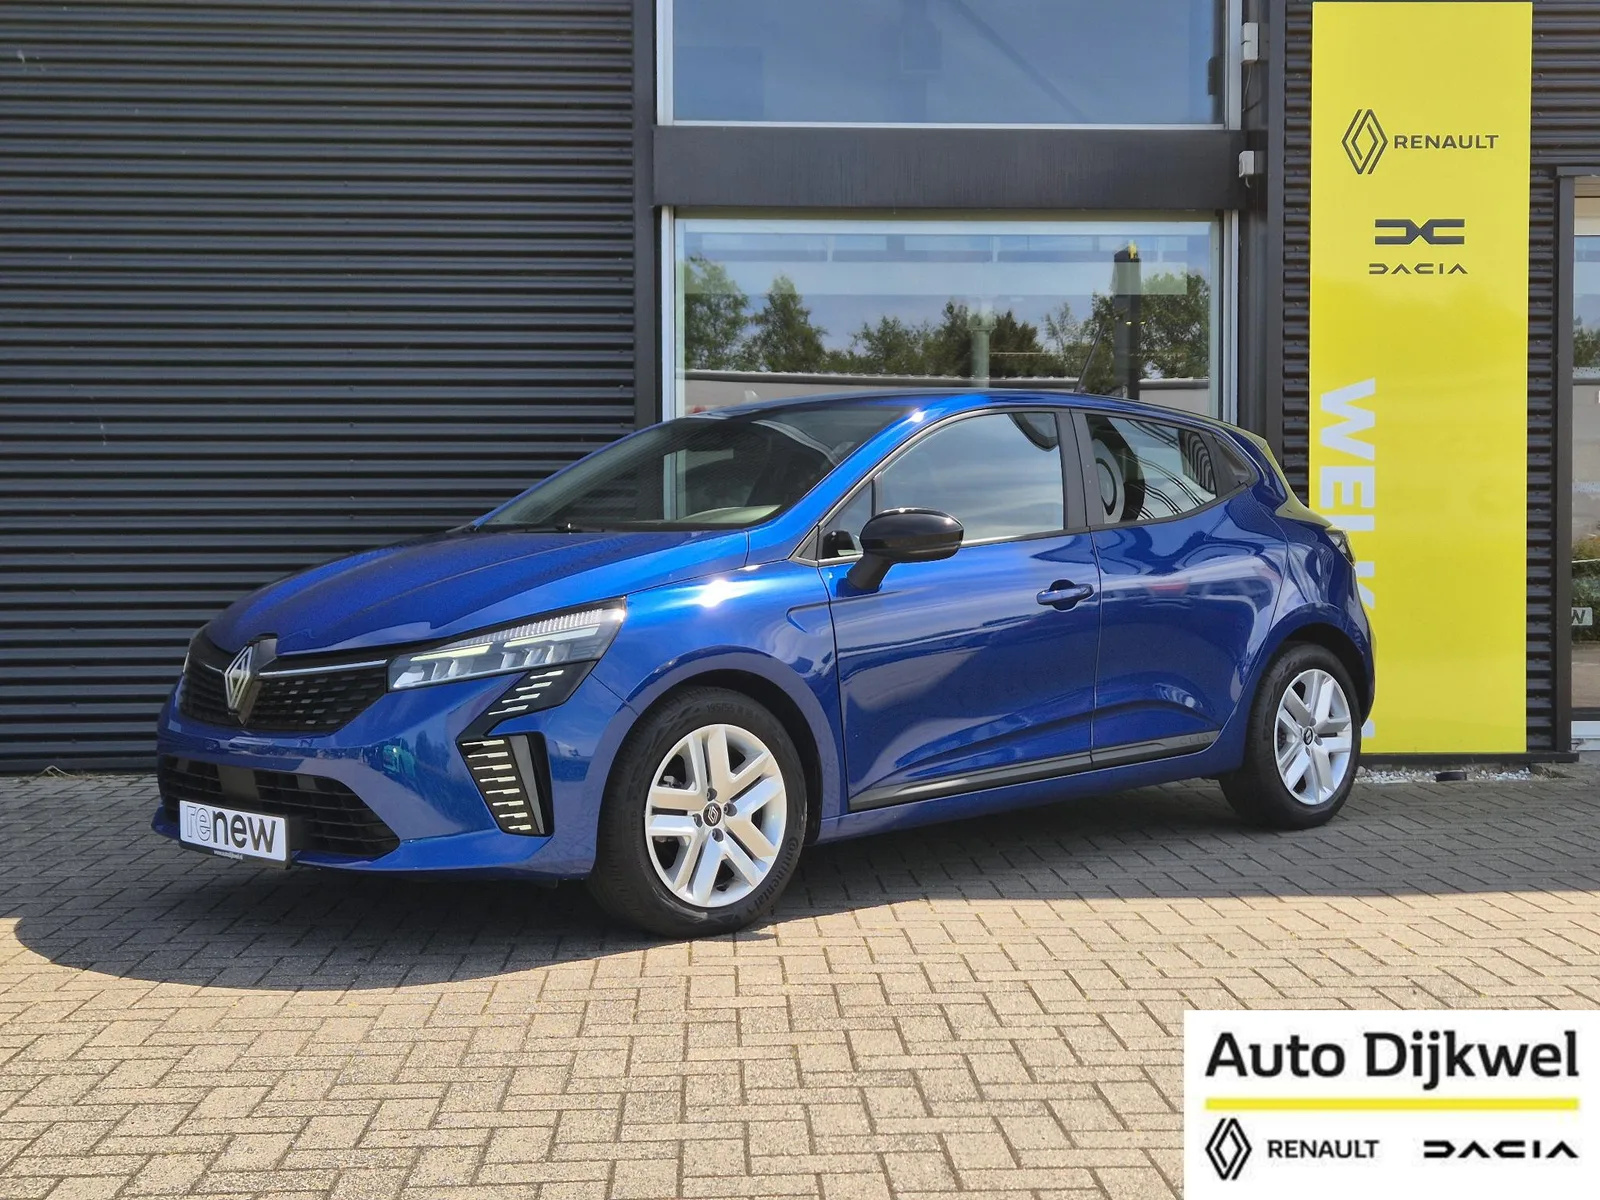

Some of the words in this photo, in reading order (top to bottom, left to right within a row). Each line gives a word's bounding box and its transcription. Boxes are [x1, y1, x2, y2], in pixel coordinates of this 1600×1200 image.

[1393, 134, 1499, 149] RENAULT
[1368, 263, 1469, 275] DACIA
[186, 805, 277, 853] renew
